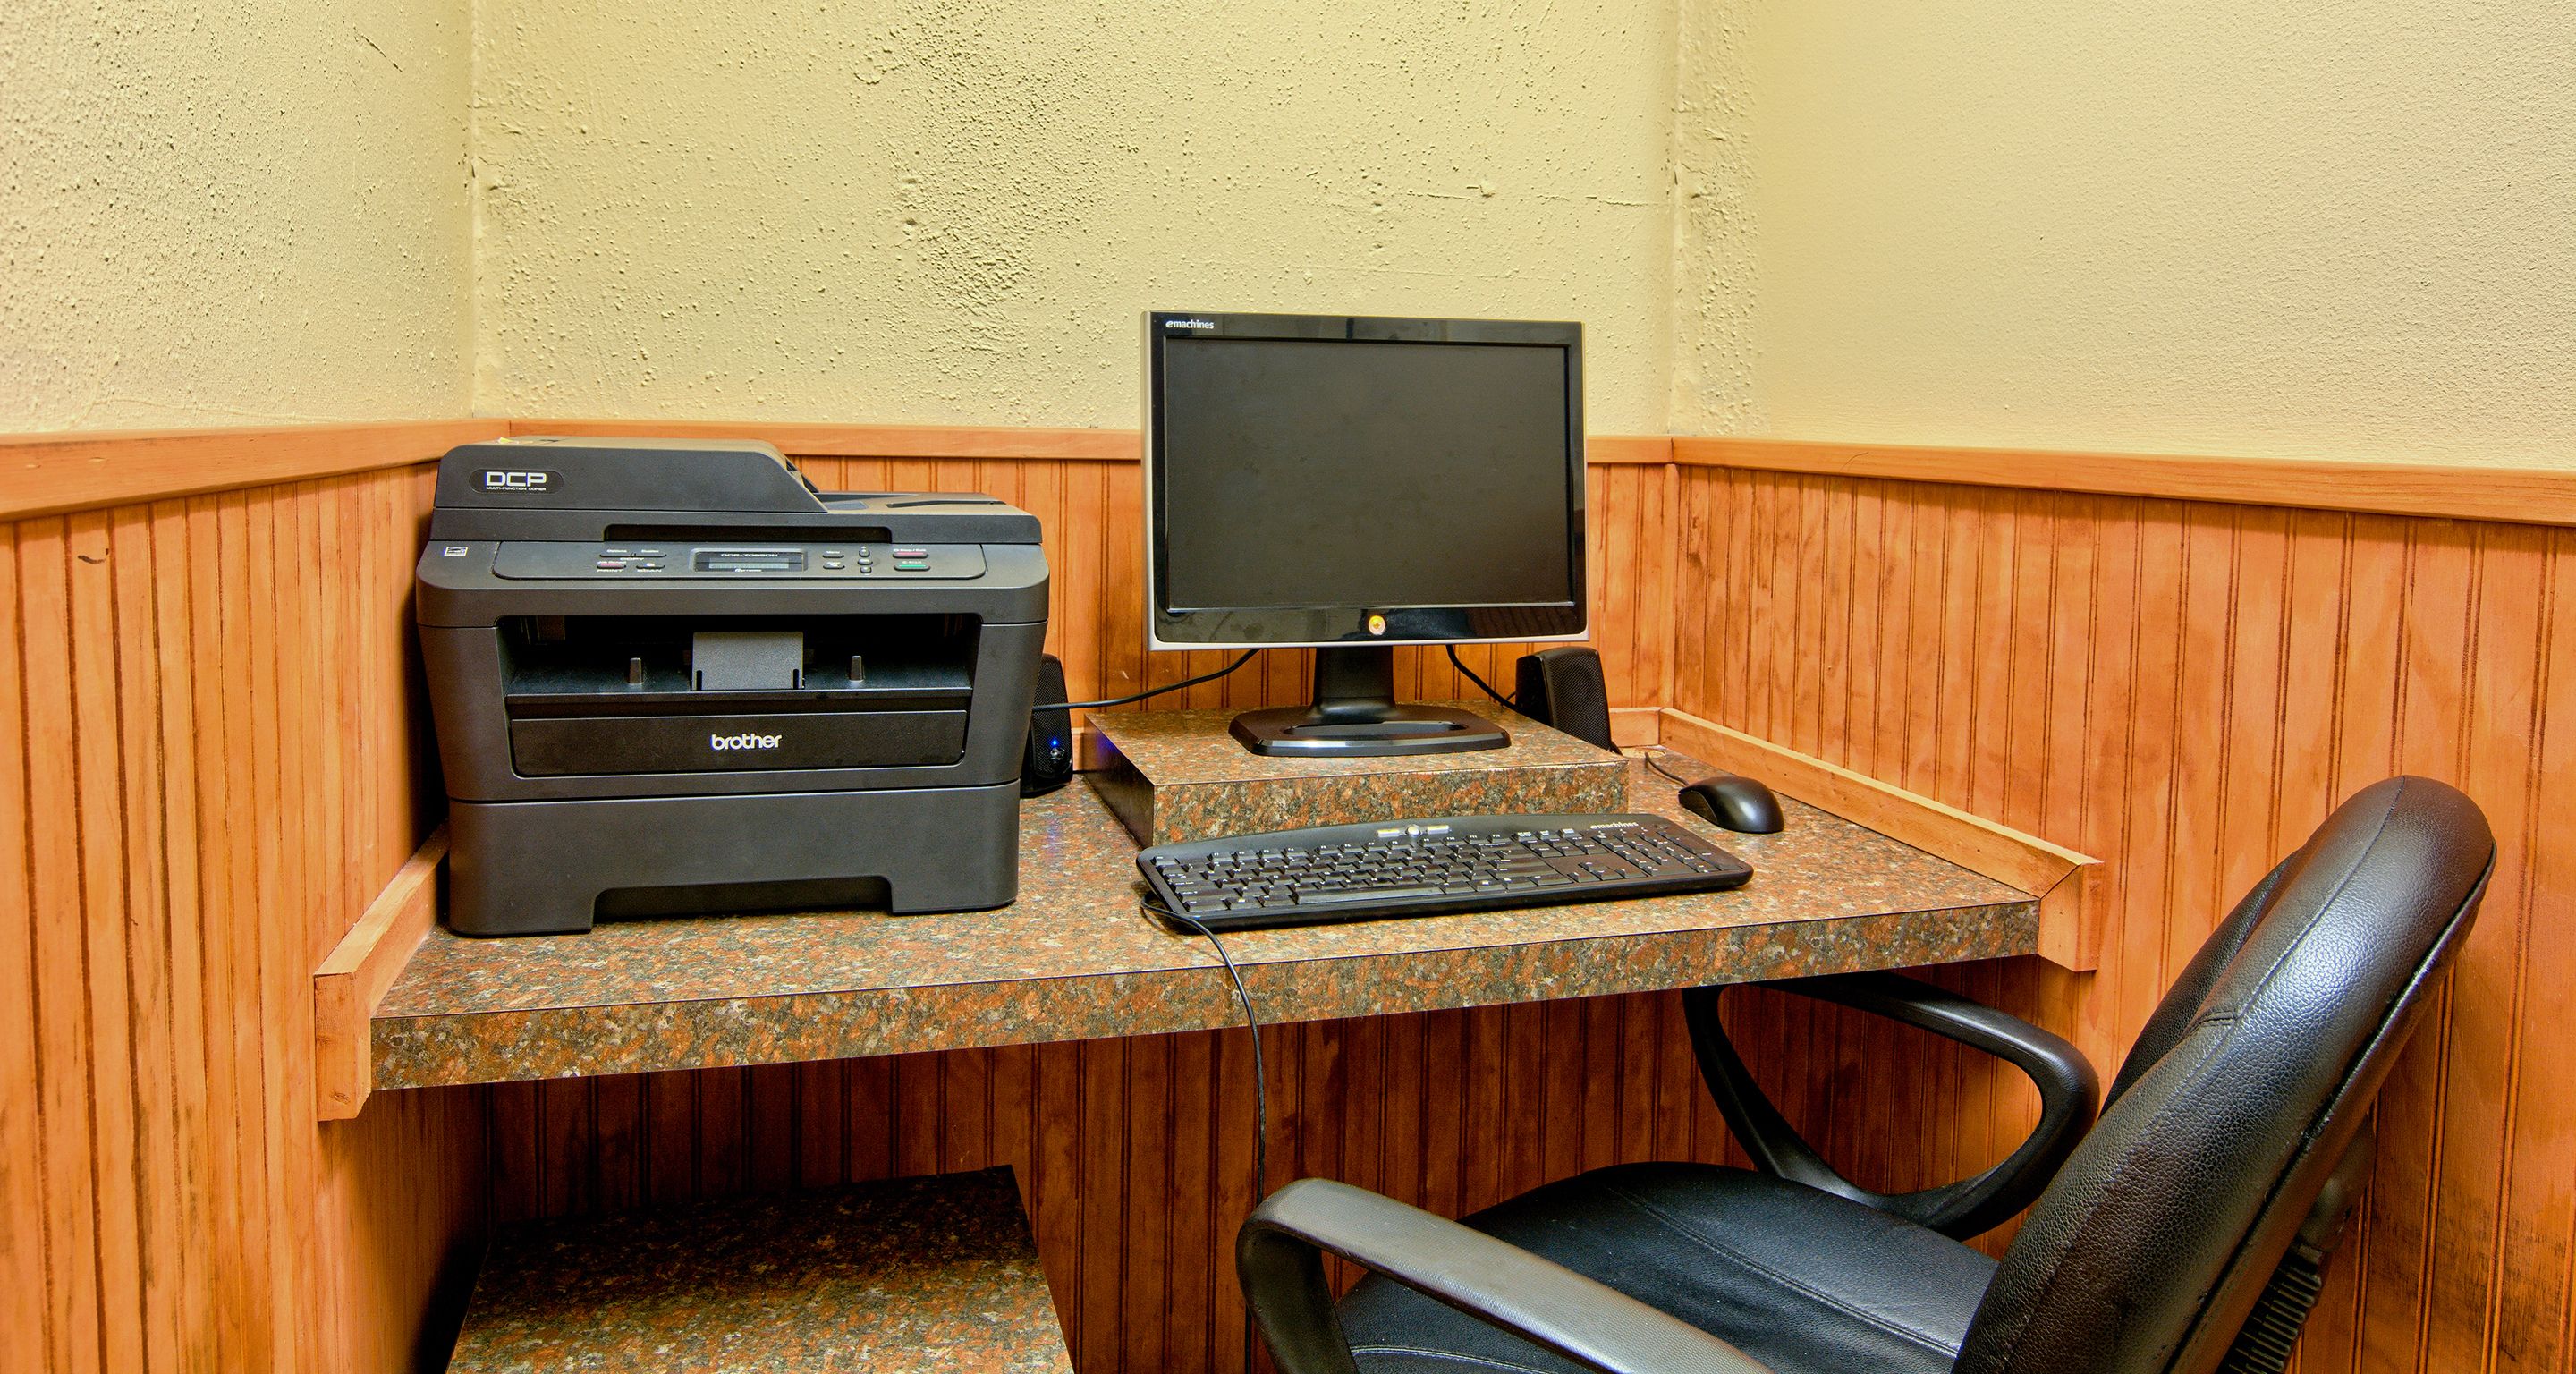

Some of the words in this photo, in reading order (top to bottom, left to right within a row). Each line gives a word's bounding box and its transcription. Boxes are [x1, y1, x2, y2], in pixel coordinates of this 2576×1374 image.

[1165, 319, 1215, 329] emachines
[486, 471, 547, 487] DCP
[711, 733, 783, 751] brother
[1590, 821, 1639, 830] emachines
